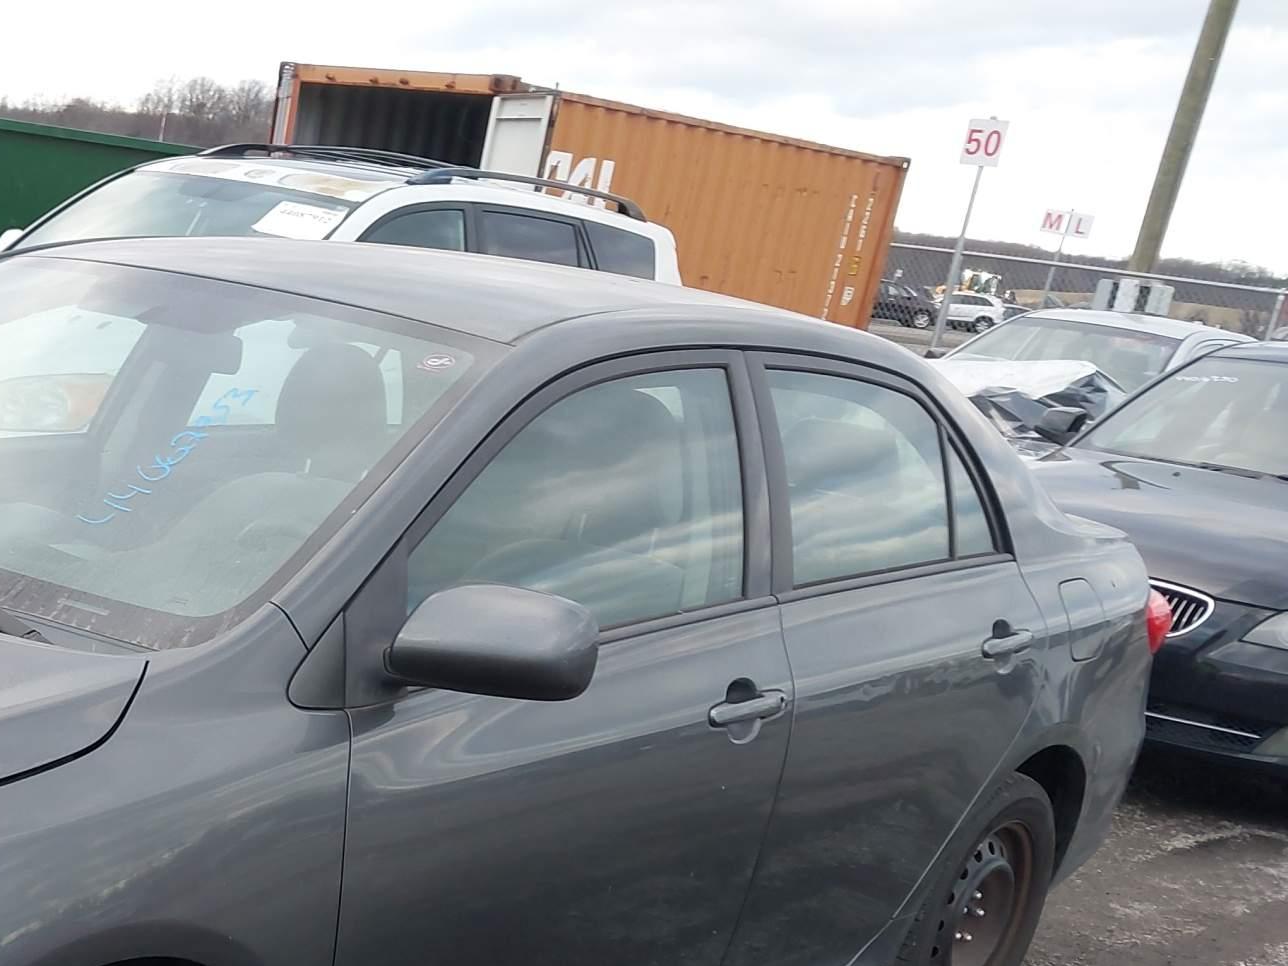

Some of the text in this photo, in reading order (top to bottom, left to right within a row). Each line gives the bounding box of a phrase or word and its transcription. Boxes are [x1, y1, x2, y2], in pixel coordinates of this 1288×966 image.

[965, 128, 1002, 157] 50
[1041, 211, 1064, 231] M
[1074, 217, 1086, 235] L
